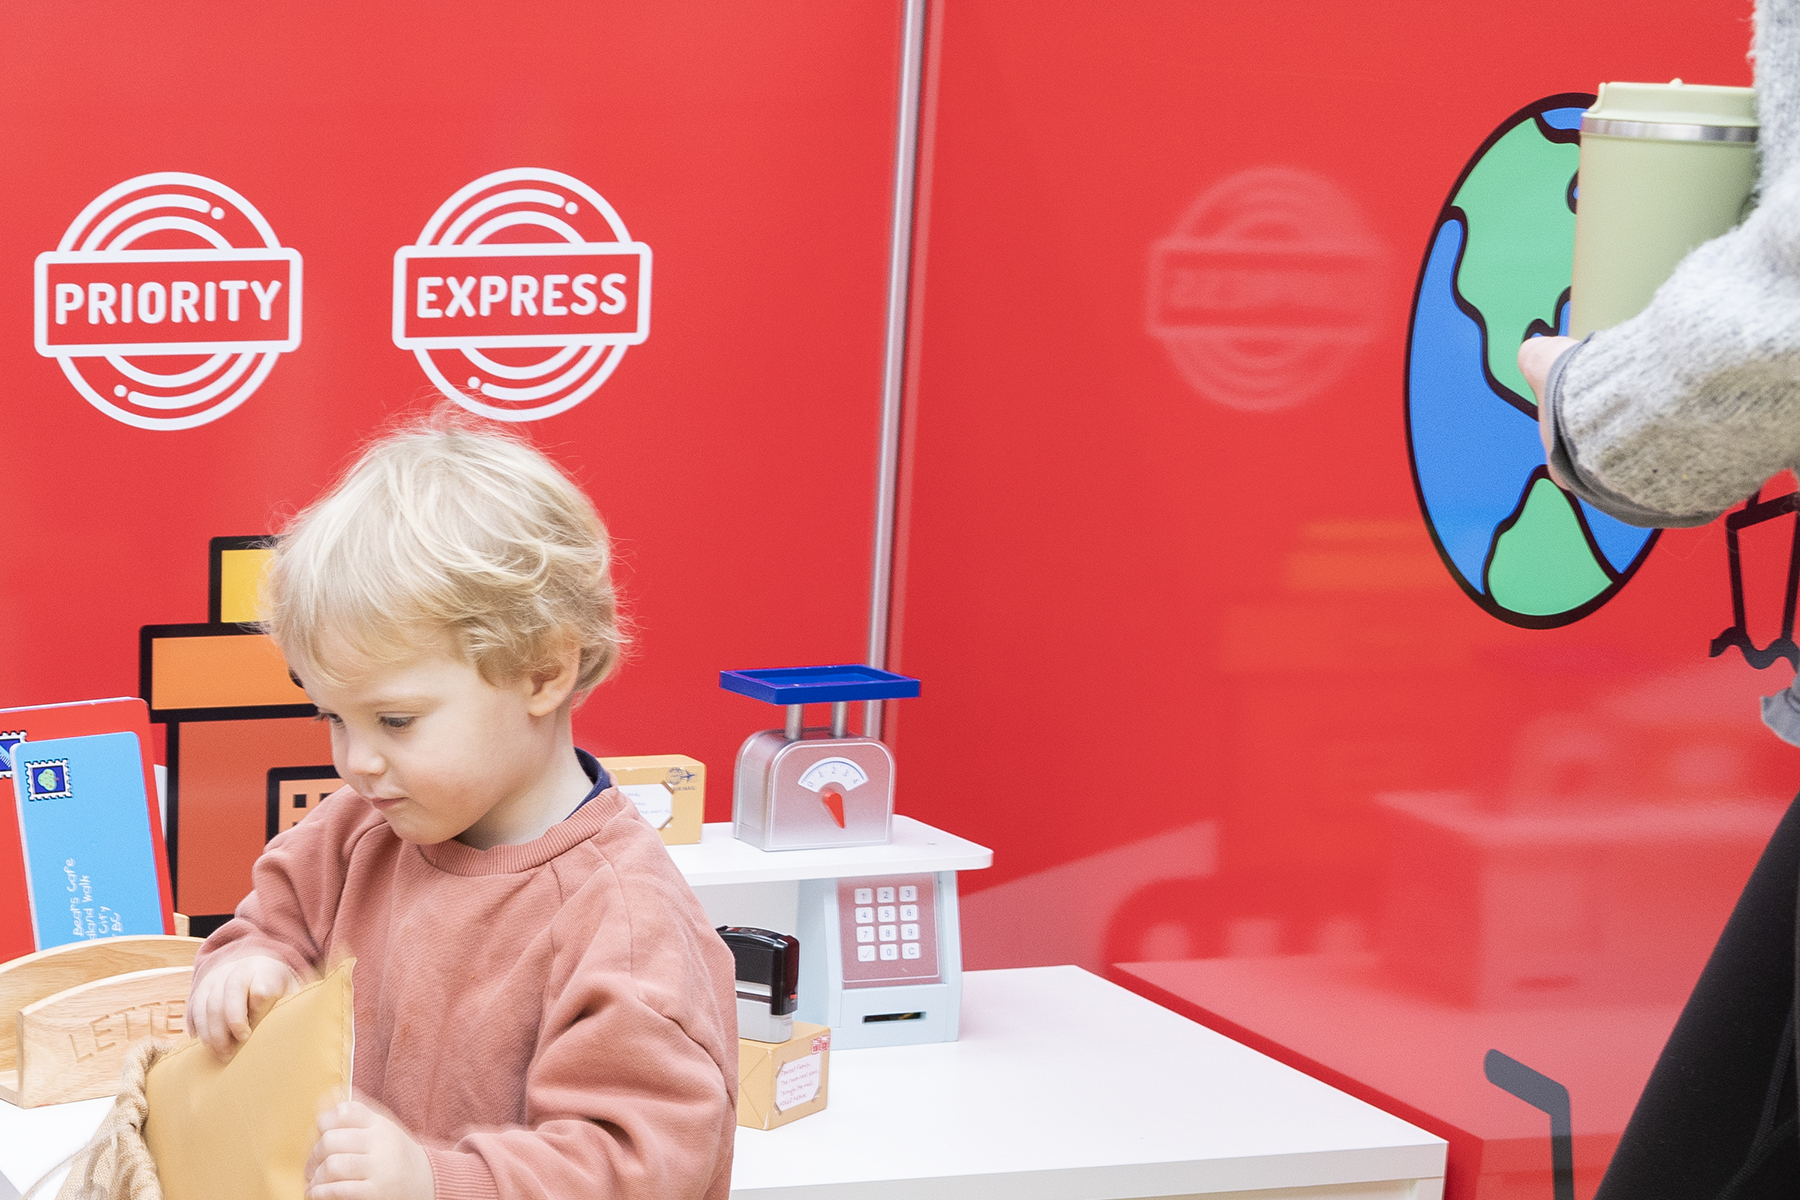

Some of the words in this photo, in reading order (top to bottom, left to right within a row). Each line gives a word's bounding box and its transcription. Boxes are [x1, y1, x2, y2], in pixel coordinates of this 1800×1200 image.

[55, 279, 283, 325] PRIORITY
[417, 273, 628, 319] EXPRESS
[68, 1000, 186, 1063] LETTE
